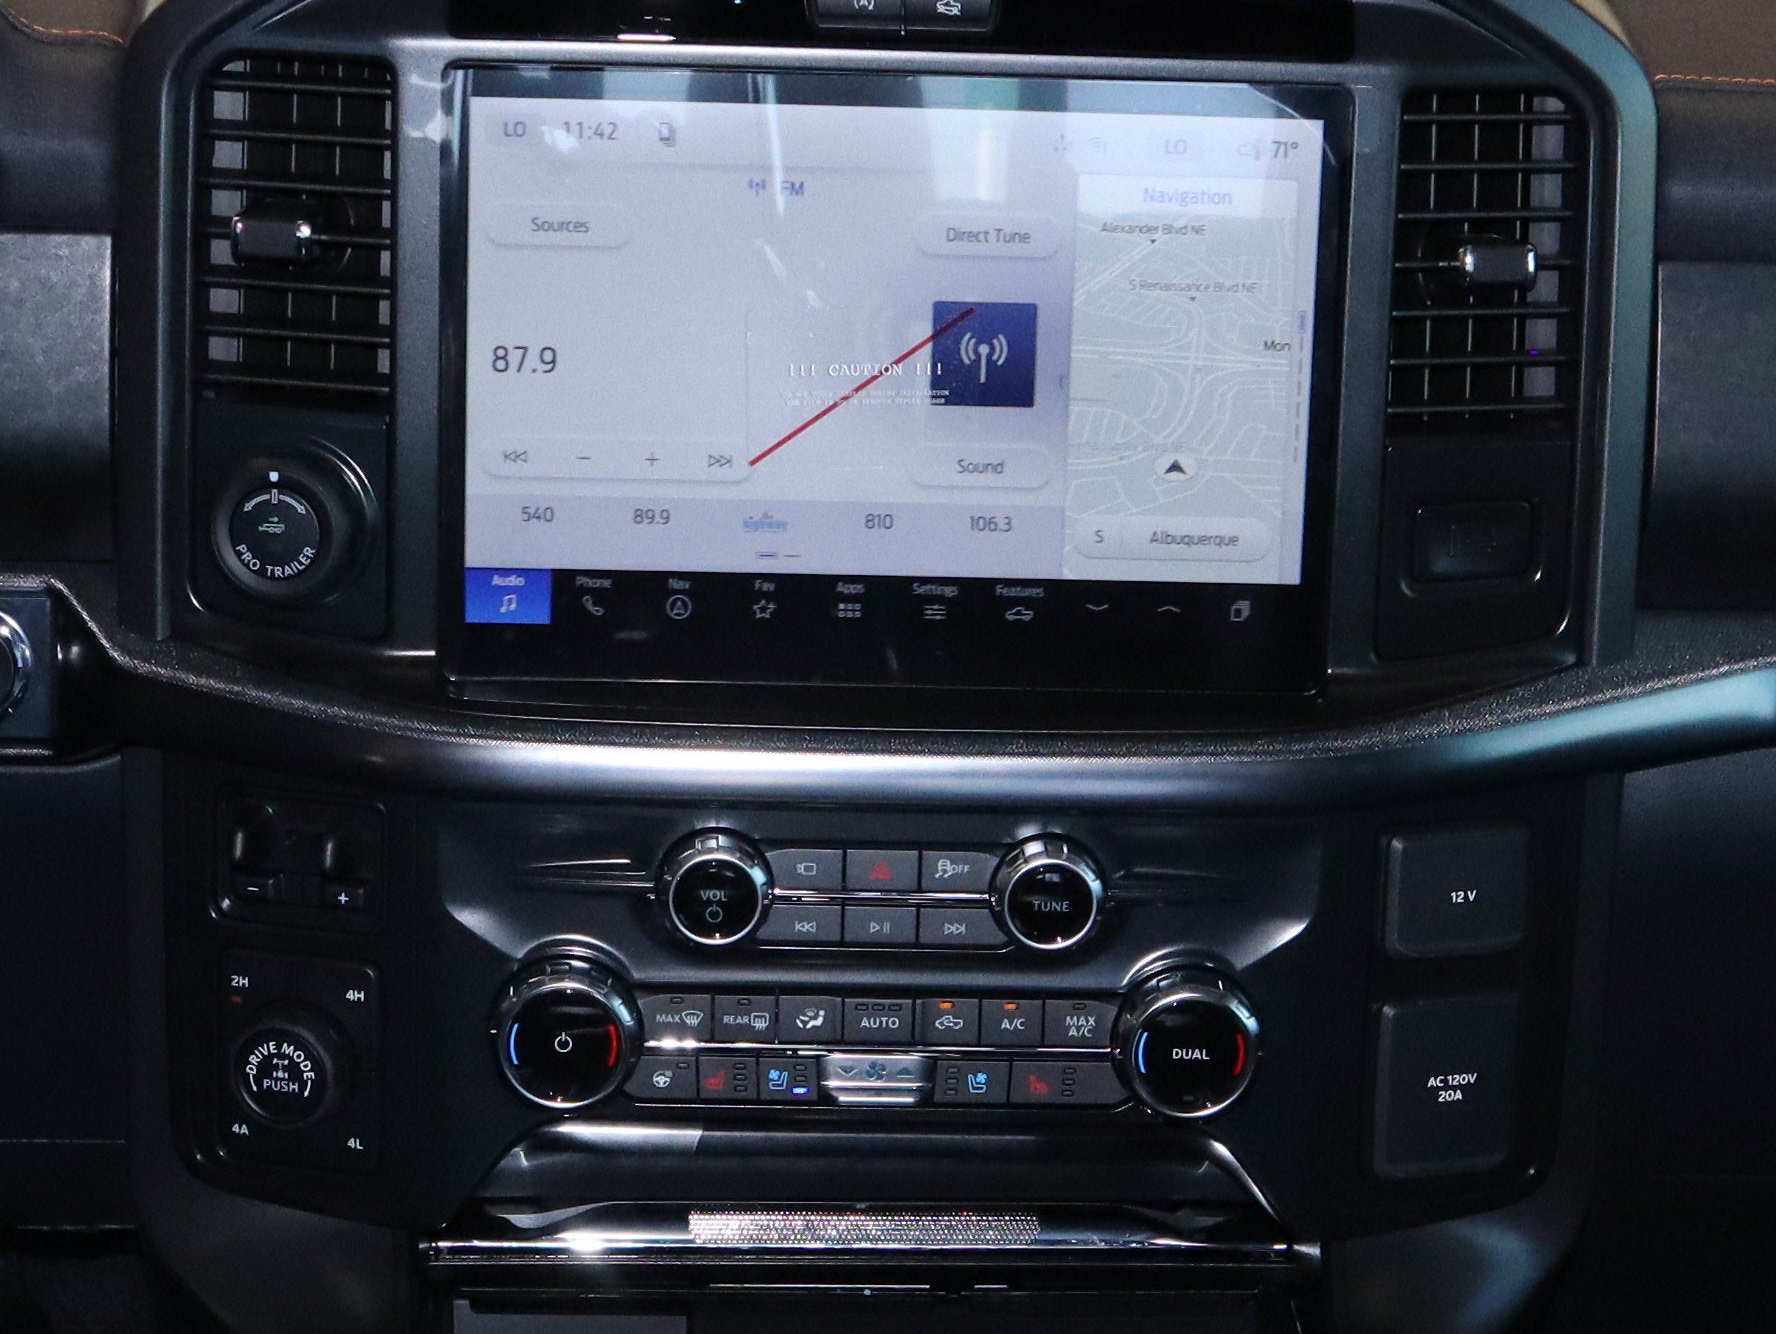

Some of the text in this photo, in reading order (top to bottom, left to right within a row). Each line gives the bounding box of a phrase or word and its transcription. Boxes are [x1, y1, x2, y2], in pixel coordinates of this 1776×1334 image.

[503, 121, 527, 138] LO
[562, 120, 619, 141] 11:42
[1142, 187, 1233, 208] Navigation
[530, 216, 590, 233] Sources
[1100, 221, 1159, 236] Alexander
[1189, 224, 1207, 236] NE
[945, 226, 1032, 245] Direct Tune
[1263, 340, 1292, 353] Mon
[491, 345, 557, 374] 87.9
[828, 362, 904, 377] CAUTION
[956, 458, 1004, 475] Sound
[521, 507, 555, 523] 540
[633, 509, 671, 525] 89.9
[865, 513, 894, 530] 810
[969, 516, 1013, 532] 106.3
[1094, 529, 1105, 544] S
[1149, 530, 1241, 549] Albuquerque
[236, 544, 317, 578] PRO TRAILER
[491, 573, 526, 587] Audio
[575, 576, 612, 589] Phone
[668, 577, 692, 590] Nav
[754, 580, 777, 593] Fav
[836, 581, 866, 596] Apps
[912, 582, 959, 599] Settings
[995, 584, 1045, 598] Features
[951, 862, 971, 875] OFF
[700, 890, 728, 902] VOL
[1450, 889, 1477, 903] 12 V
[1032, 900, 1070, 913] TUNE
[230, 975, 249, 988] 2H
[345, 989, 365, 1002] 4H
[656, 1013, 681, 1024] MAX
[723, 1014, 749, 1025] REAR
[859, 1016, 900, 1029] AUTO
[1000, 1017, 1026, 1032] A/C
[1065, 1015, 1097, 1027] MAX
[1068, 1026, 1094, 1038] A/C
[245, 1041, 316, 1081] DRIVE MODE
[1172, 1048, 1211, 1060] DUAL
[263, 1078, 299, 1093] PUSH
[1427, 1073, 1478, 1087] AC 120V
[1438, 1089, 1463, 1102] 20A
[231, 1123, 250, 1136] 4A
[346, 1137, 364, 1150] 4L
